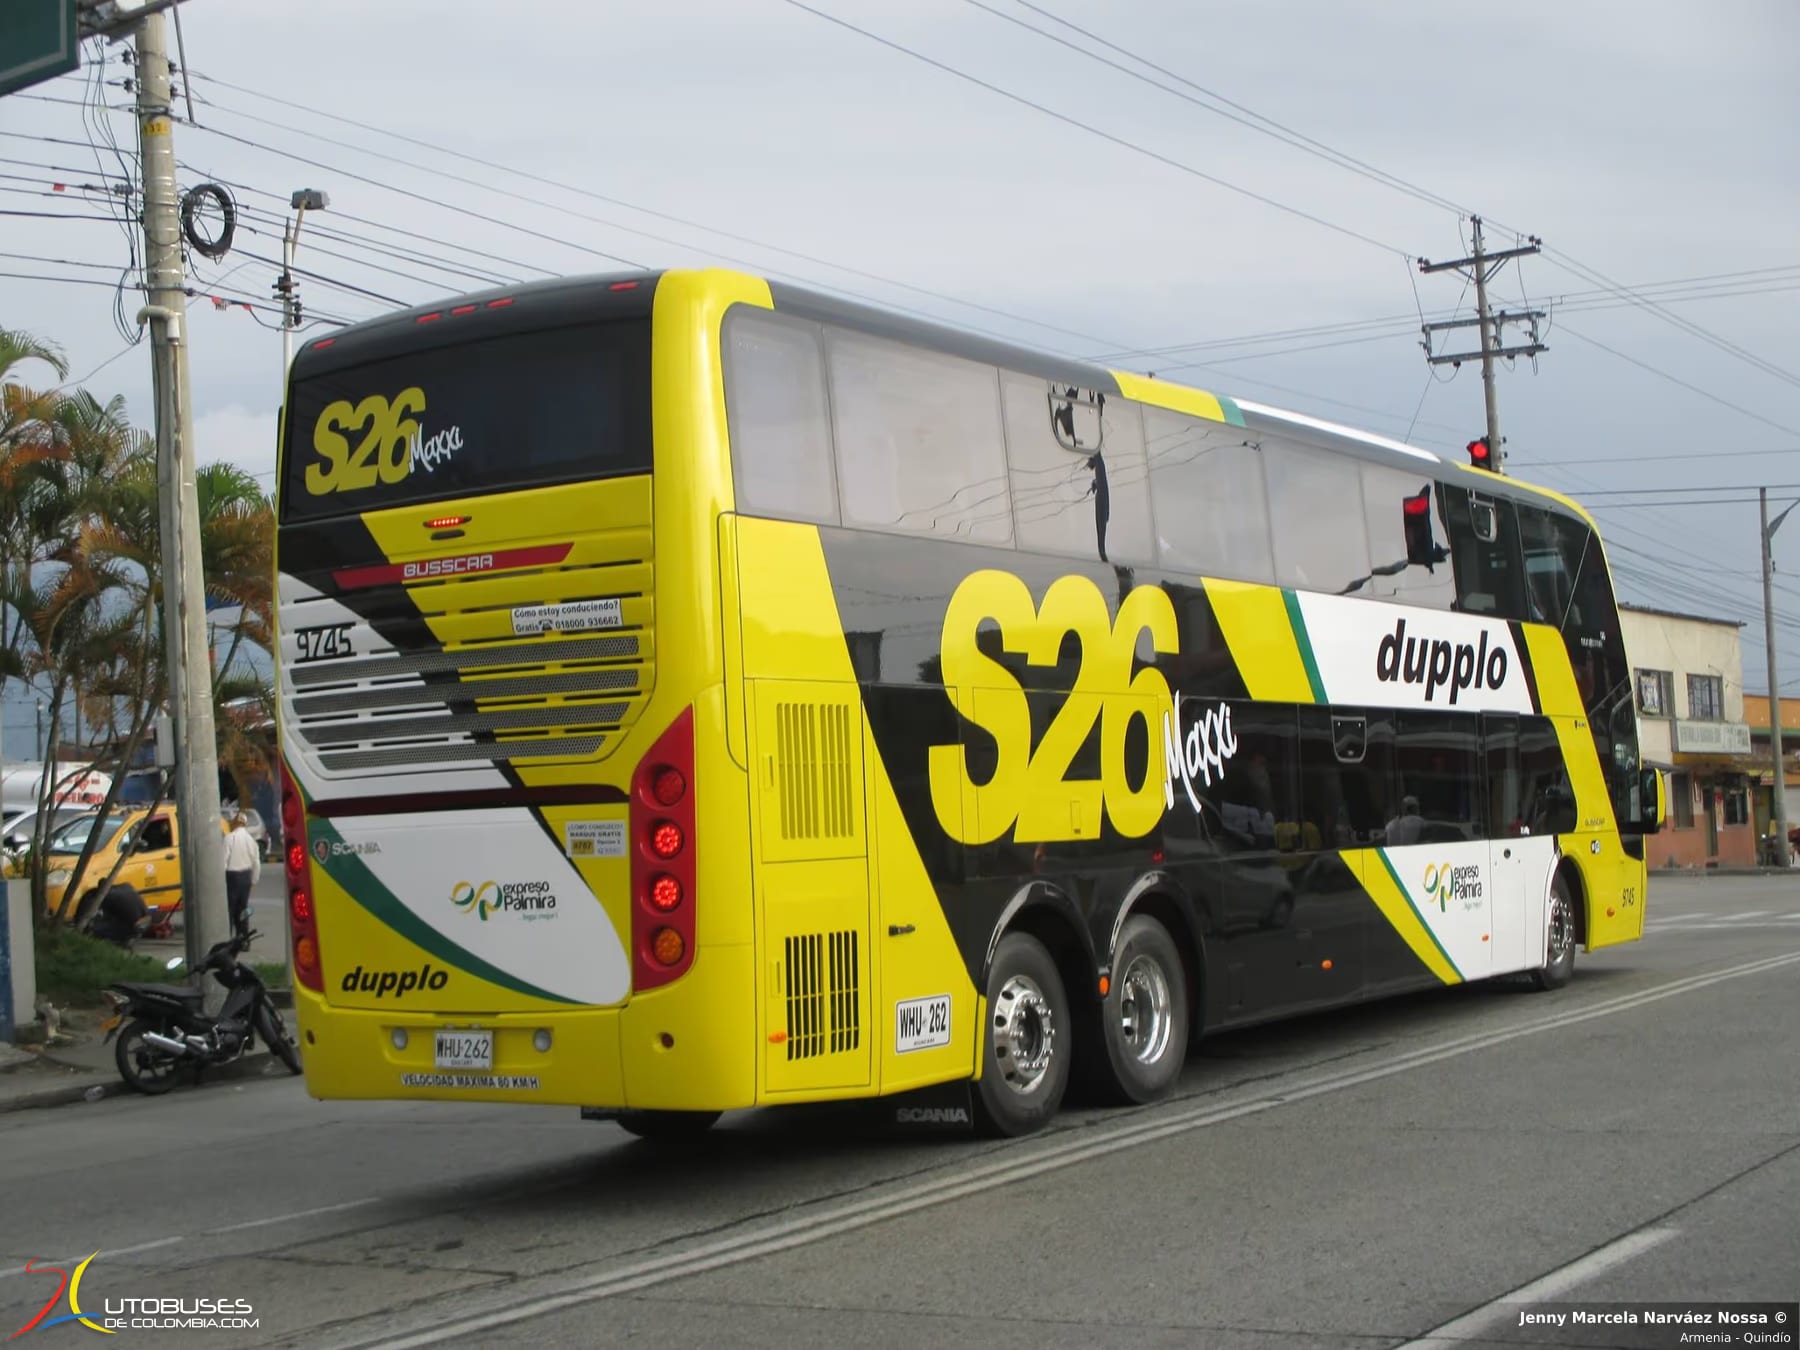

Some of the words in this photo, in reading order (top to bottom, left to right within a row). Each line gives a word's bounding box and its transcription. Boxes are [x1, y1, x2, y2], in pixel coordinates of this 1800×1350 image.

[305, 387, 426, 495] S26
[409, 424, 464, 474] Maxxi
[404, 555, 494, 578] BUSSCAR
[538, 606, 560, 617] estoy
[561, 600, 618, 614] conduciendo?
[515, 623, 540, 633] Gratis
[297, 628, 352, 658] 9745
[1377, 619, 1507, 704] dupplo
[928, 569, 1180, 846] S26
[1163, 690, 1238, 813] Maxxi
[503, 881, 550, 895] expreso
[1455, 881, 1483, 901] Palmira
[504, 893, 557, 912] Palmira
[341, 965, 448, 997] dupplo
[402, 1075, 454, 1087] VELOCIDAD
[897, 1107, 968, 1122] SCANIA
